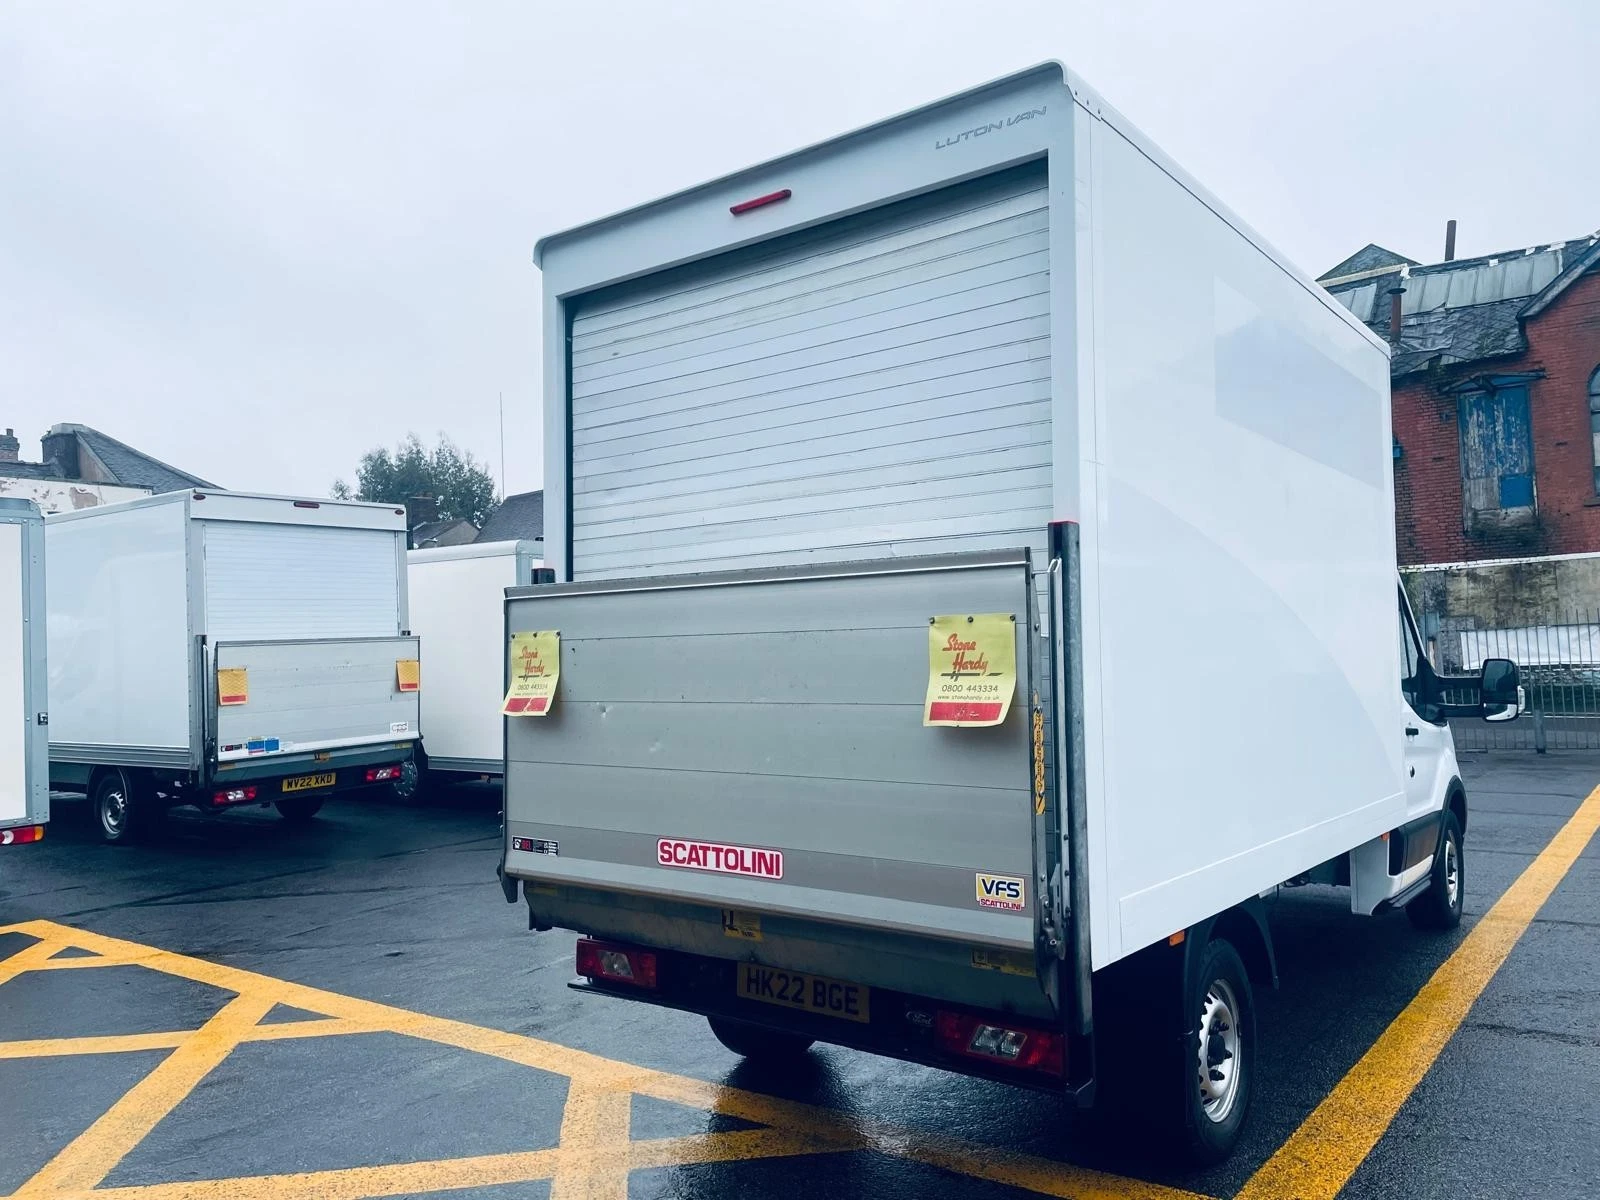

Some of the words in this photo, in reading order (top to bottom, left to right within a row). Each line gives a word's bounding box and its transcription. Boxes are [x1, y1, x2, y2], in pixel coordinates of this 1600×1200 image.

[936, 120, 1003, 149] LUTON
[1006, 105, 1047, 126] VAN
[942, 633, 977, 651] Stone
[952, 652, 988, 675] Hardy
[942, 684, 963, 692] 0800
[966, 684, 999, 692] 443334
[287, 777, 312, 788] WV22
[314, 774, 332, 785] XKD
[660, 841, 780, 876] SCATTOLINI
[981, 879, 1020, 898] VFS
[980, 899, 1021, 910] SCATTOLINI
[746, 967, 805, 1004] HK22
[812, 980, 859, 1015] BGE
